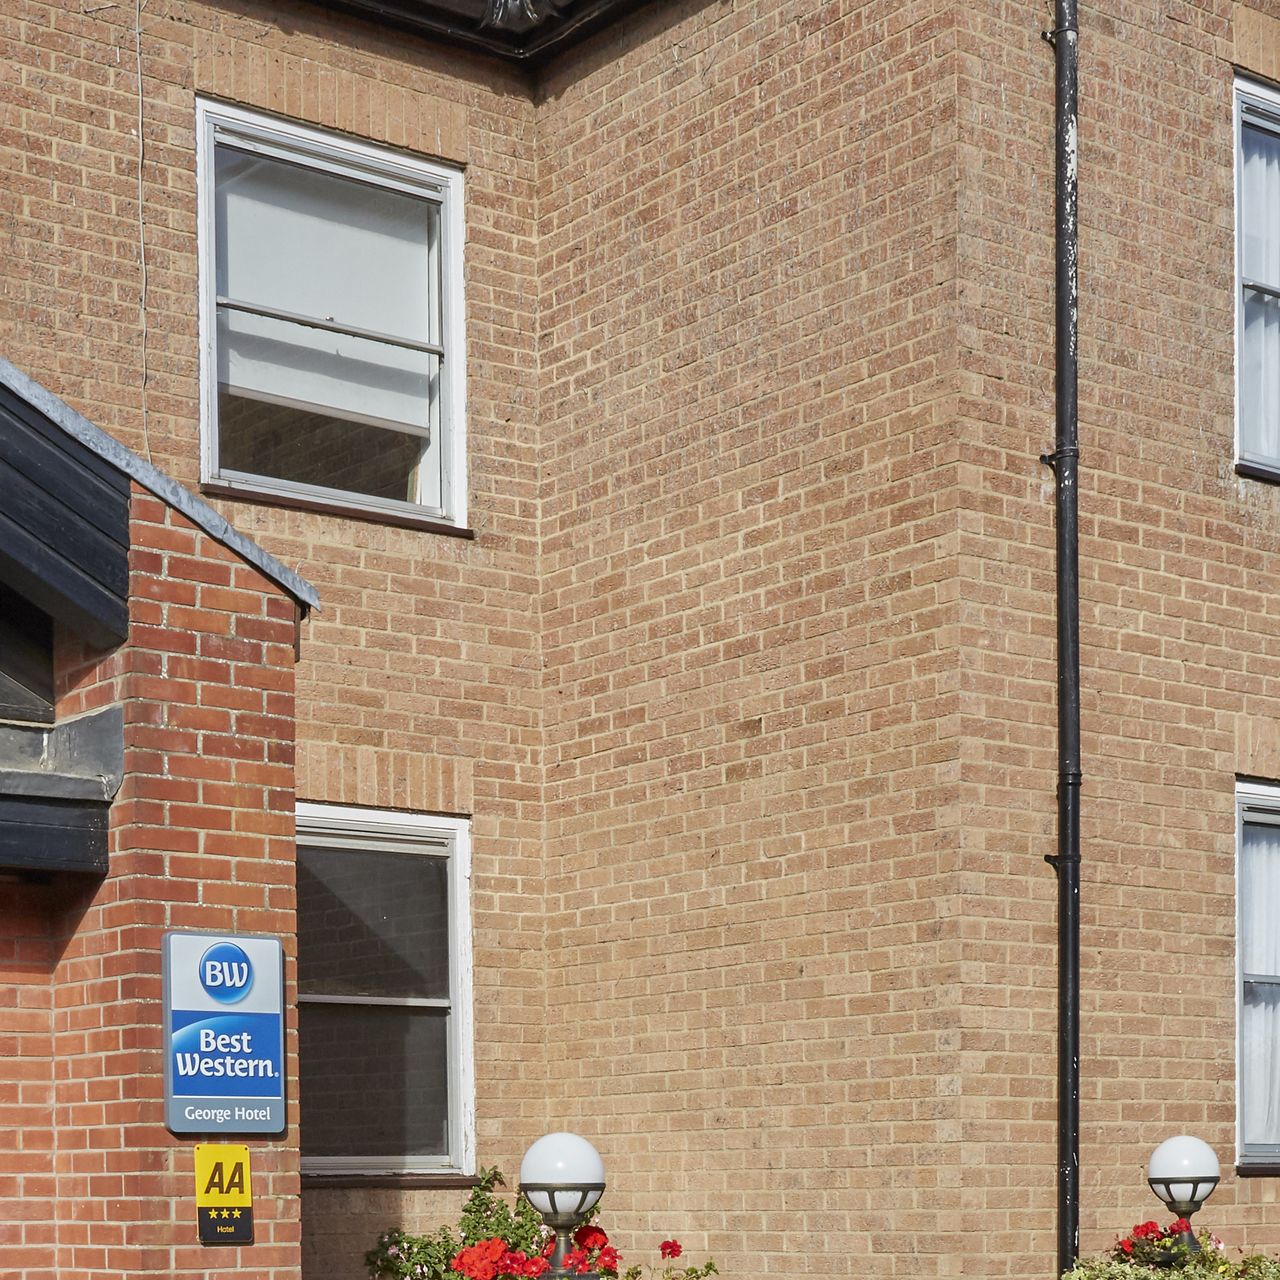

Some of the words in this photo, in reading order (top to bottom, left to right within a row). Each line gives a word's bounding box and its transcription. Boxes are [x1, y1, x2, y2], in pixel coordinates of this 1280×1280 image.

[204, 960, 248, 988] BW
[200, 1029, 252, 1054] Best
[184, 1106, 231, 1122] George
[234, 1106, 271, 1121] Hotel
[204, 1161, 245, 1194] AA
